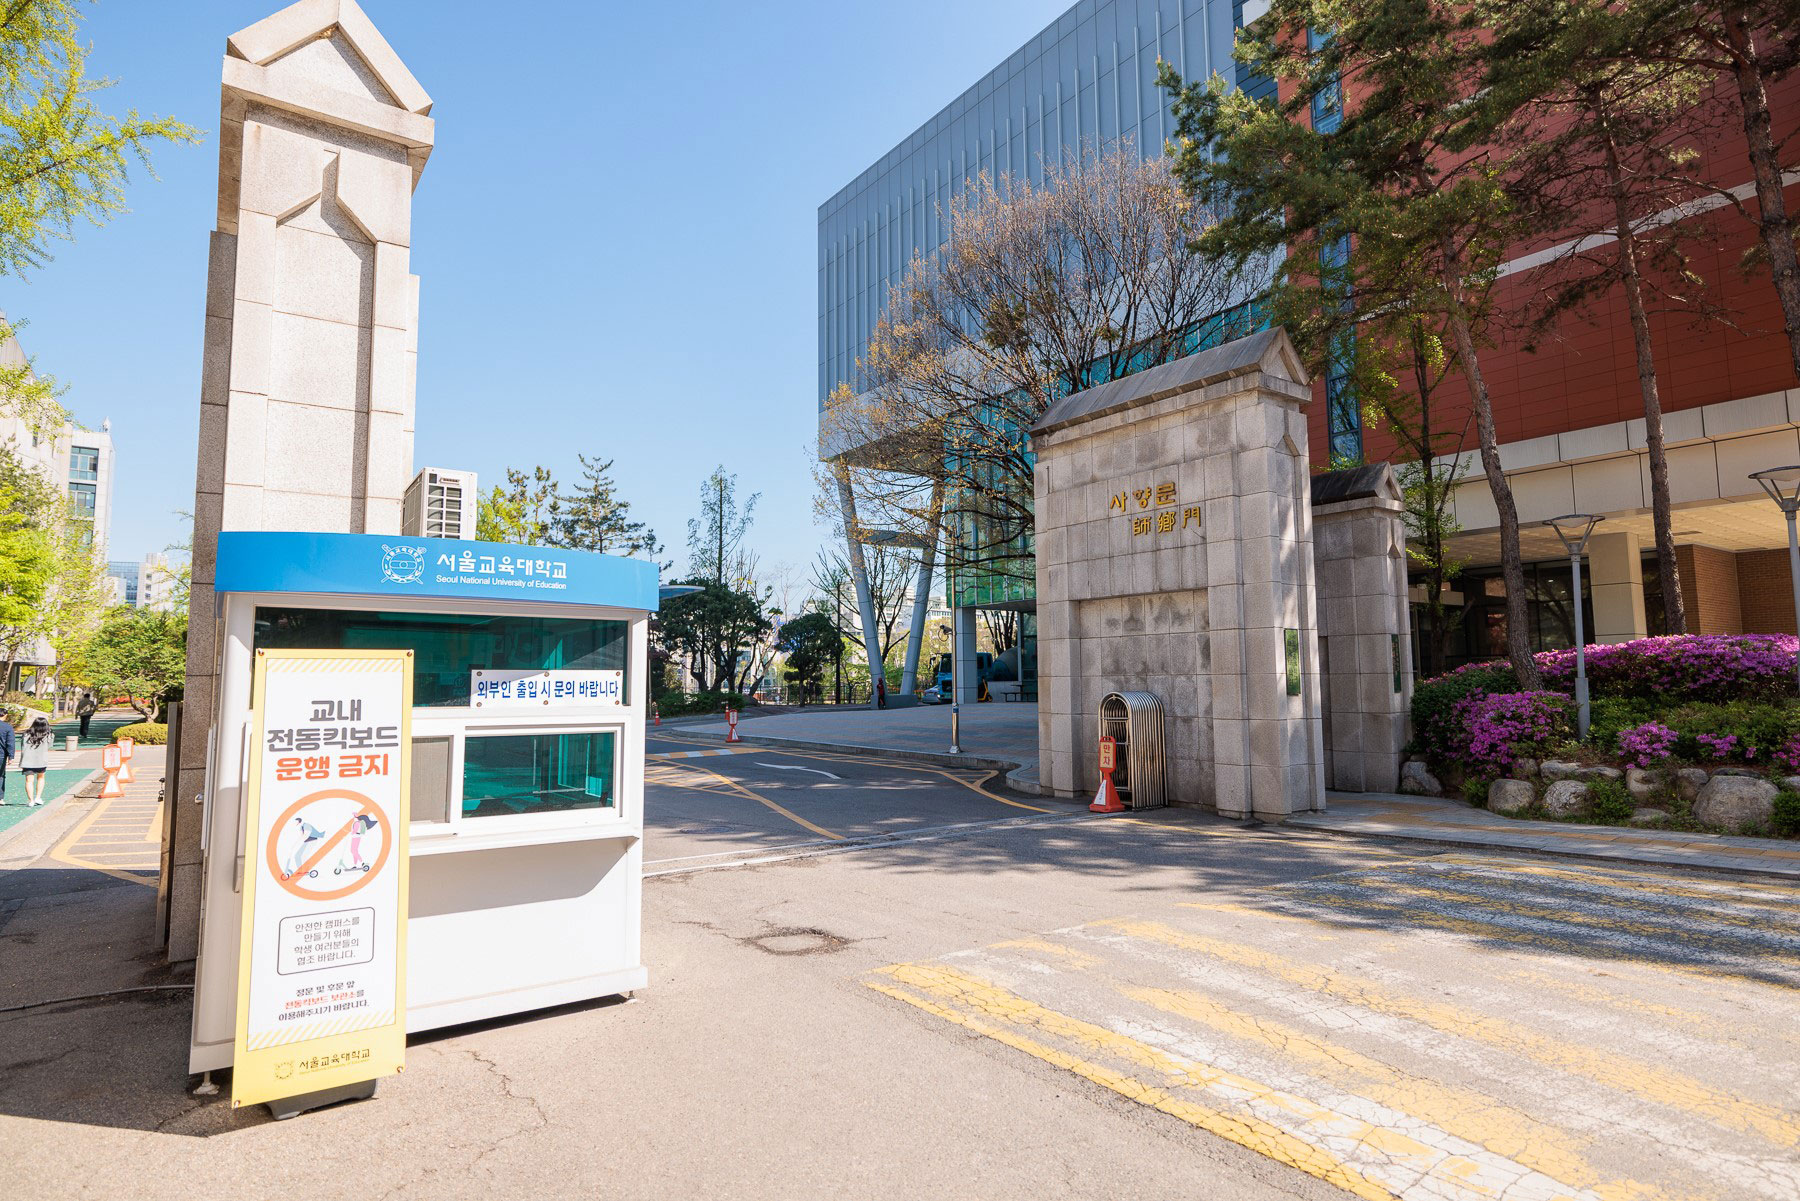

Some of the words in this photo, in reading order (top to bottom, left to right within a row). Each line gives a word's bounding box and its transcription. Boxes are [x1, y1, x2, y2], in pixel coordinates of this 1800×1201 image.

[436, 550, 567, 579] 서울교육대학교
[436, 575, 458, 584] Seoul
[460, 576, 490, 585] National
[492, 578, 526, 589] University
[527, 580, 534, 588] of
[535, 581, 567, 590] Education
[477, 680, 511, 698] 외부인
[516, 680, 538, 699] 출입
[541, 680, 550, 698] 시
[554, 680, 575, 698] 문의
[578, 680, 618, 697] 바랍니다
[309, 699, 362, 721] 교내
[267, 726, 399, 752] 전동킥보드
[275, 755, 330, 781] 운행
[338, 753, 389, 778] 금지
[295, 921, 323, 933] 안전한
[325, 916, 360, 929] 캠퍼스를
[304, 931, 331, 943] 만들기
[333, 928, 351, 939] 위해
[294, 944, 312, 955] 학생
[315, 938, 359, 952] 여러분들의
[297, 955, 315, 966] 협조
[317, 949, 356, 963] 바랍니다.
[296, 987, 314, 997] 정문
[316, 985, 325, 994] 및
[327, 982, 344, 992] 후문
[346, 980, 355, 989] 앞
[285, 995, 329, 1010] 전동킥보드
[331, 989, 365, 1002] 보관소를
[278, 1005, 331, 1022] 이용해주시기
[333, 999, 370, 1012] 바랍니다.
[299, 1048, 370, 1069] 서울교육대학교
